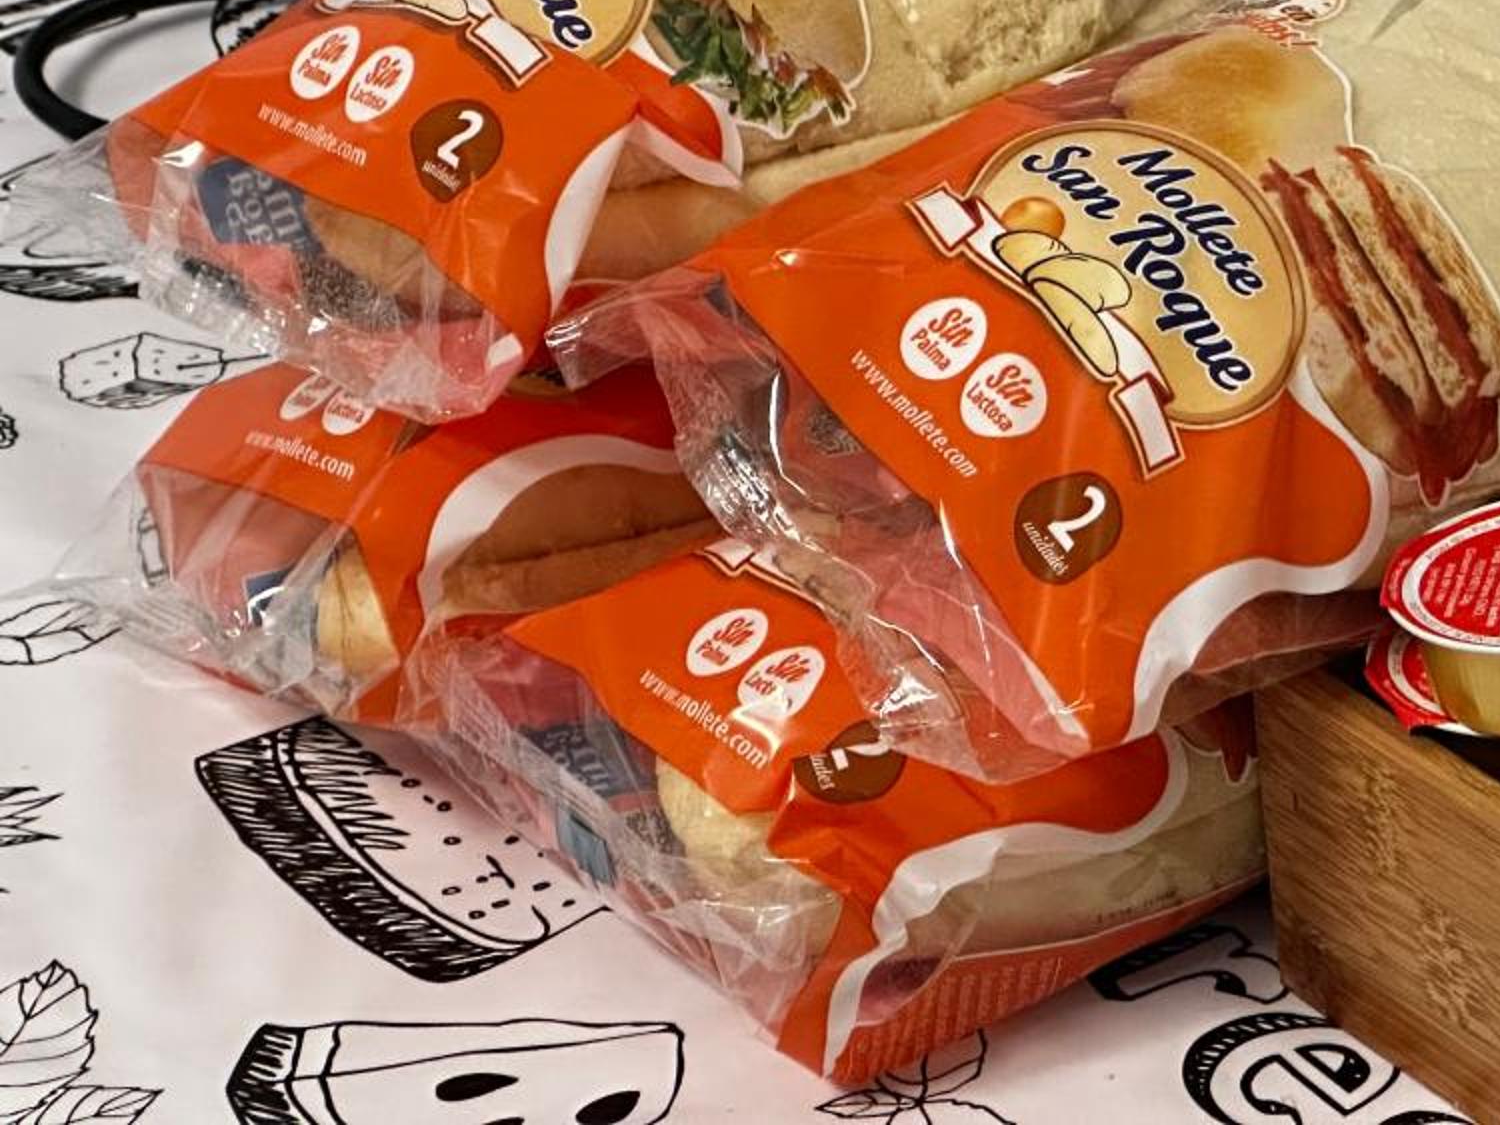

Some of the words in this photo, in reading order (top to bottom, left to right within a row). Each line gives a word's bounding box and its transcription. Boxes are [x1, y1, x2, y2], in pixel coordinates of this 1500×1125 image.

[310, 31, 352, 64] Sin
[364, 52, 402, 89] Sin
[256, 100, 368, 167] www.mollete.com
[437, 109, 485, 170] 2
[1116, 145, 1268, 302] Mollete
[1020, 143, 1120, 223] San
[1108, 210, 1258, 394] Roque
[909, 328, 952, 372] Palma
[927, 306, 975, 351] Sin
[965, 383, 1014, 433] Lactosa
[985, 363, 1033, 410] Sin
[849, 348, 979, 480] www.mollete.com
[1046, 484, 1108, 554] 2
[1020, 518, 1070, 578] unidades
[712, 616, 757, 650] Sin
[765, 648, 816, 688] Sin
